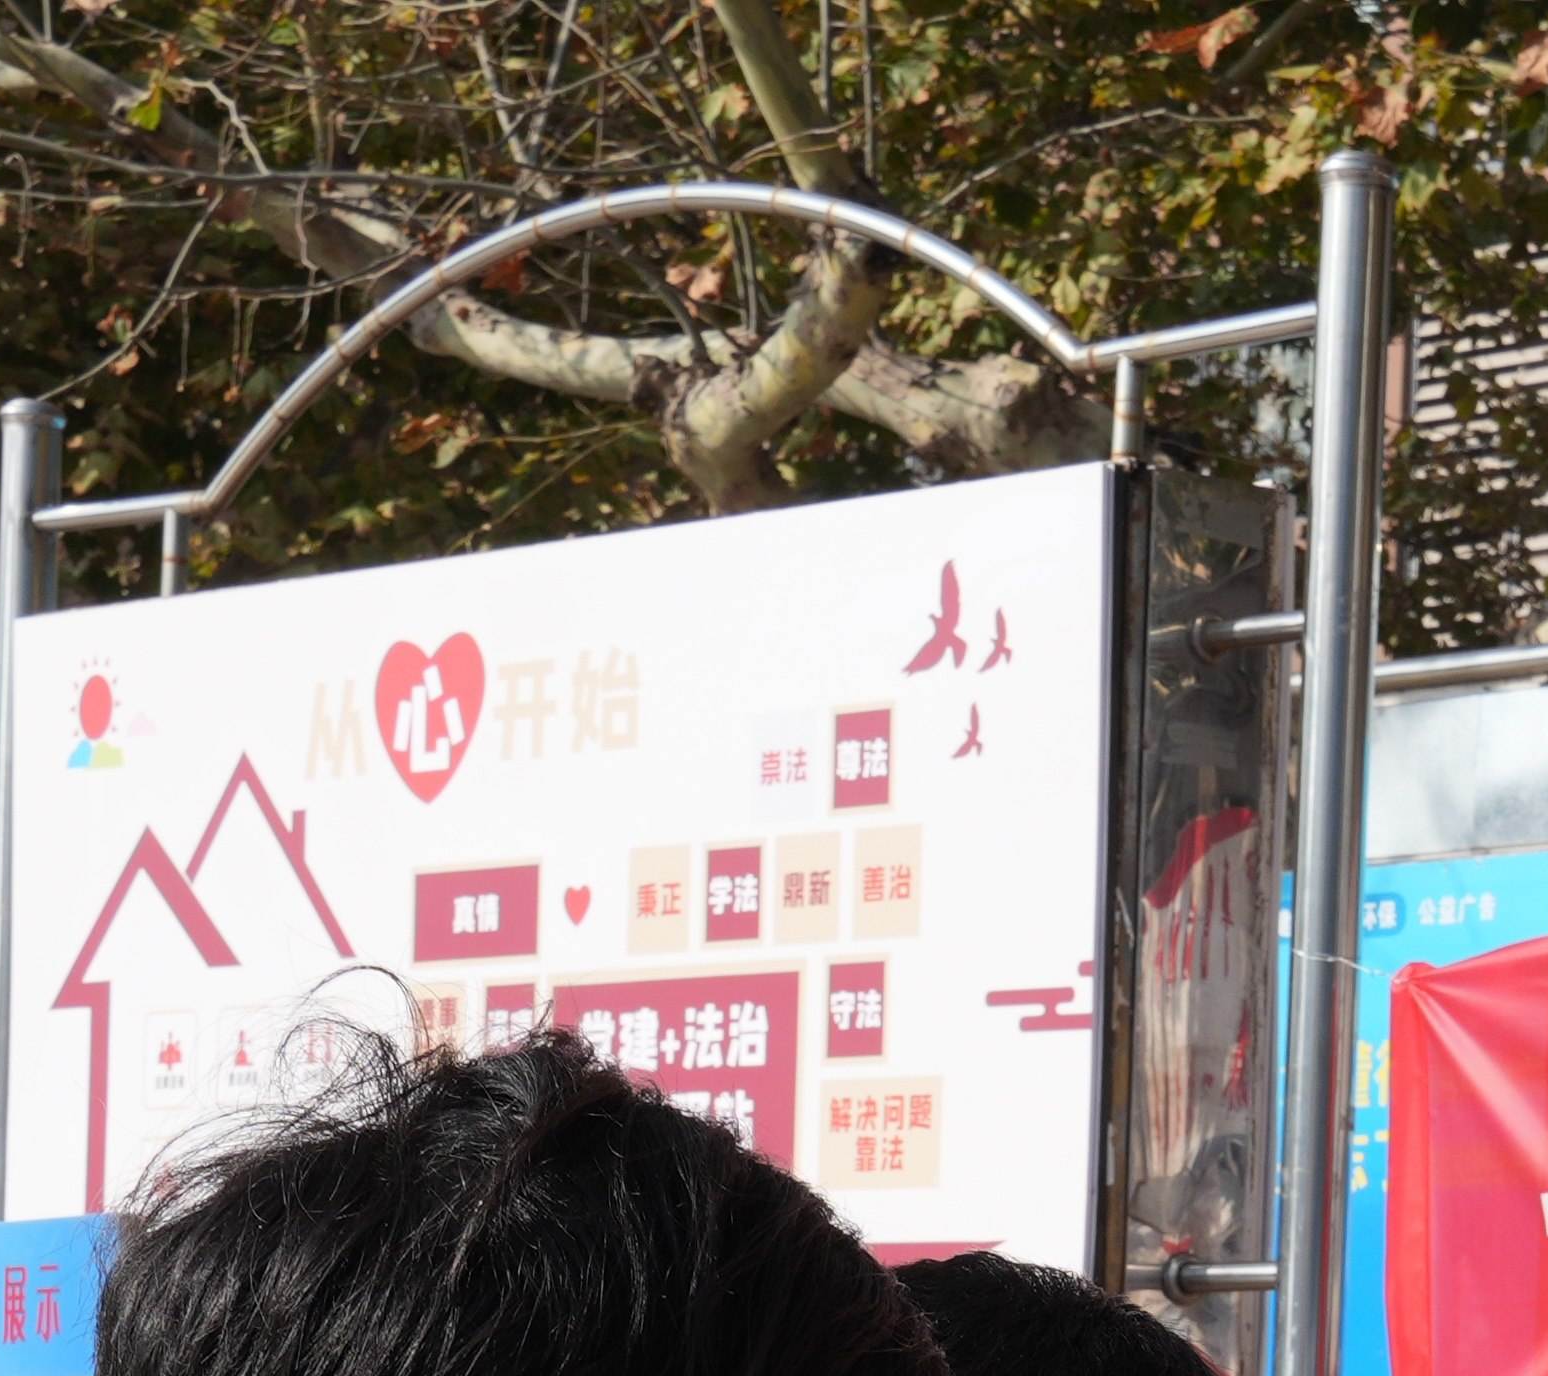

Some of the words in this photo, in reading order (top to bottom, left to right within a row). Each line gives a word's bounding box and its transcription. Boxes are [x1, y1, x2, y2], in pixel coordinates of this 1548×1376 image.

[305, 646, 640, 781] 从心开始
[760, 748, 808, 785] 崇法
[835, 737, 889, 782] 尊法
[708, 873, 759, 915] 学法
[863, 864, 911, 903] 善治
[829, 989, 883, 1031] 守法
[830, 1094, 932, 1132] 解决问题
[855, 1136, 904, 1172] 靠法
